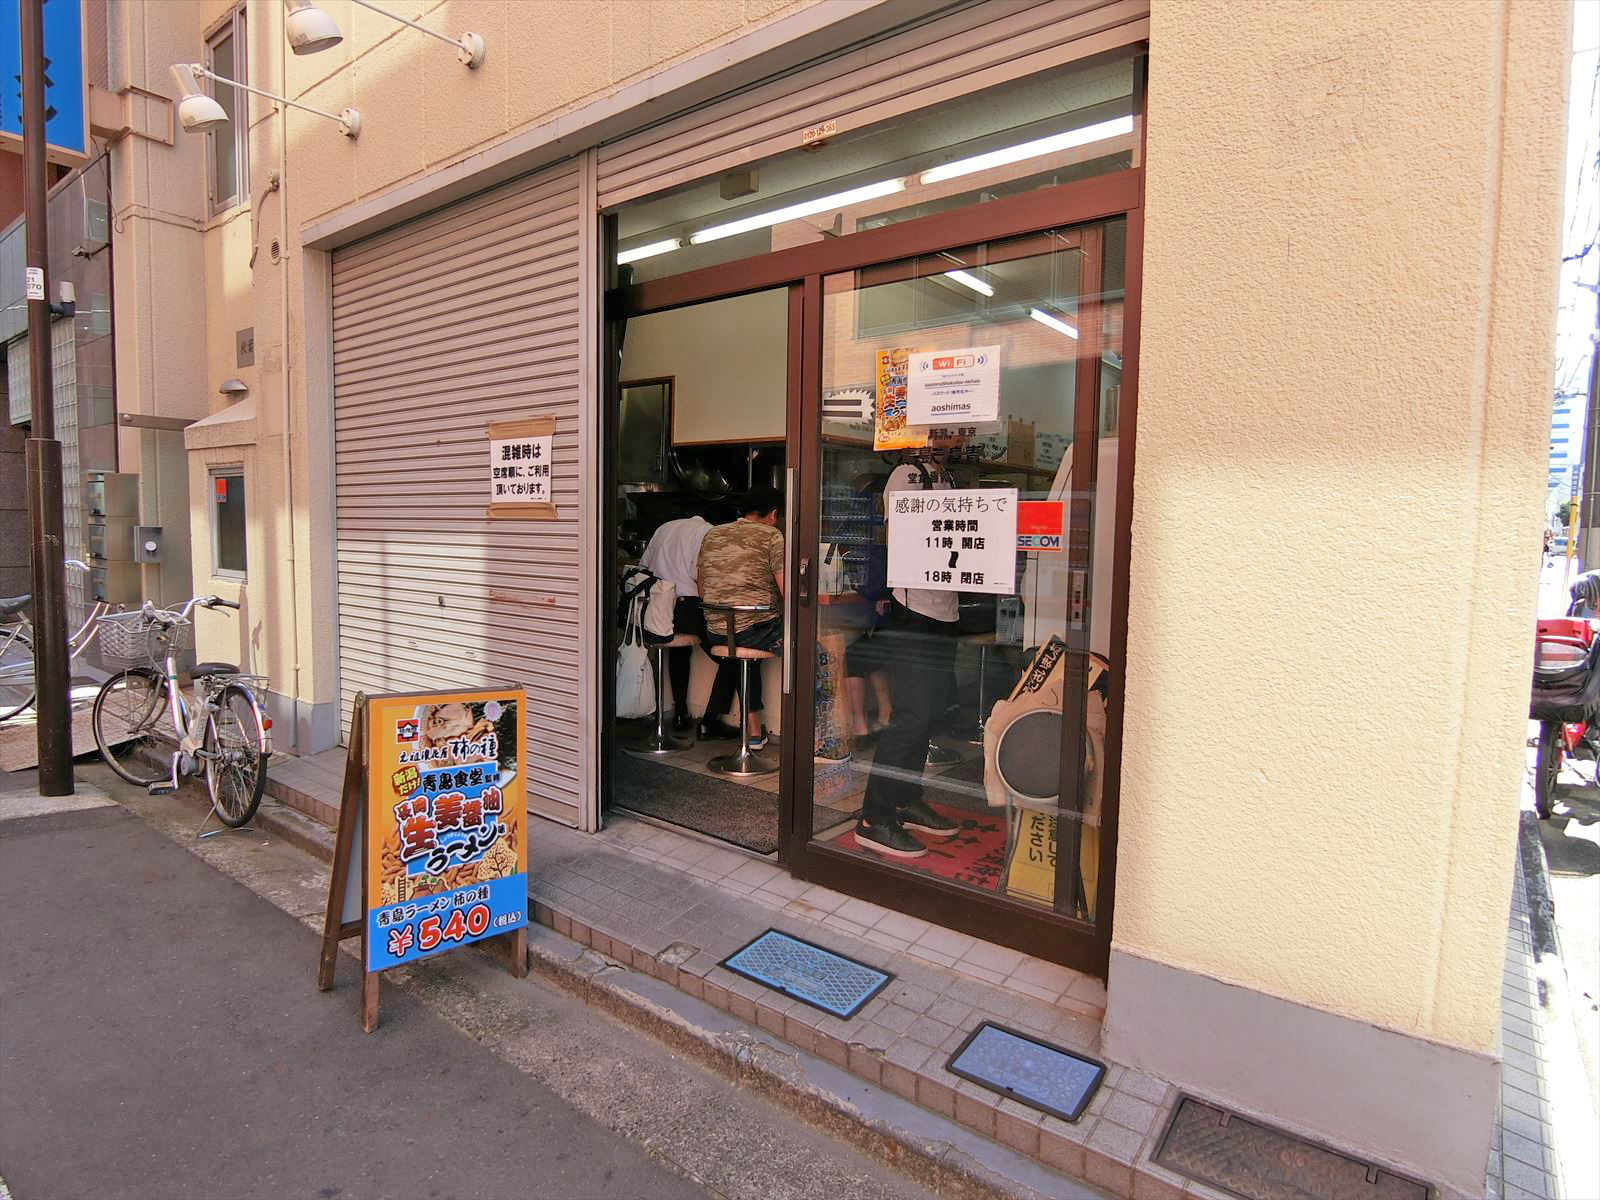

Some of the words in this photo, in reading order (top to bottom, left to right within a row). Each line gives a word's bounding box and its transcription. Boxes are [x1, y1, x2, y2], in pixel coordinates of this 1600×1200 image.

[931, 403, 971, 412] aoshimas
[502, 444, 541, 460] 混雑時は
[493, 465, 549, 479] 空席順に、ご利用
[496, 483, 546, 496] 頂いております。
[895, 496, 1007, 513] 感謝の気持ちで
[931, 520, 978, 532] 営業時間
[925, 537, 953, 549] 11時
[961, 538, 985, 549] 開店
[1018, 536, 1059, 547] SECOM
[925, 571, 952, 584] 18時
[961, 572, 984, 584] 閉店
[449, 735, 497, 761] 柿の種
[378, 898, 450, 926] 青島ラーメン
[454, 885, 489, 907] 柿の種
[389, 904, 490, 956] ¥540
